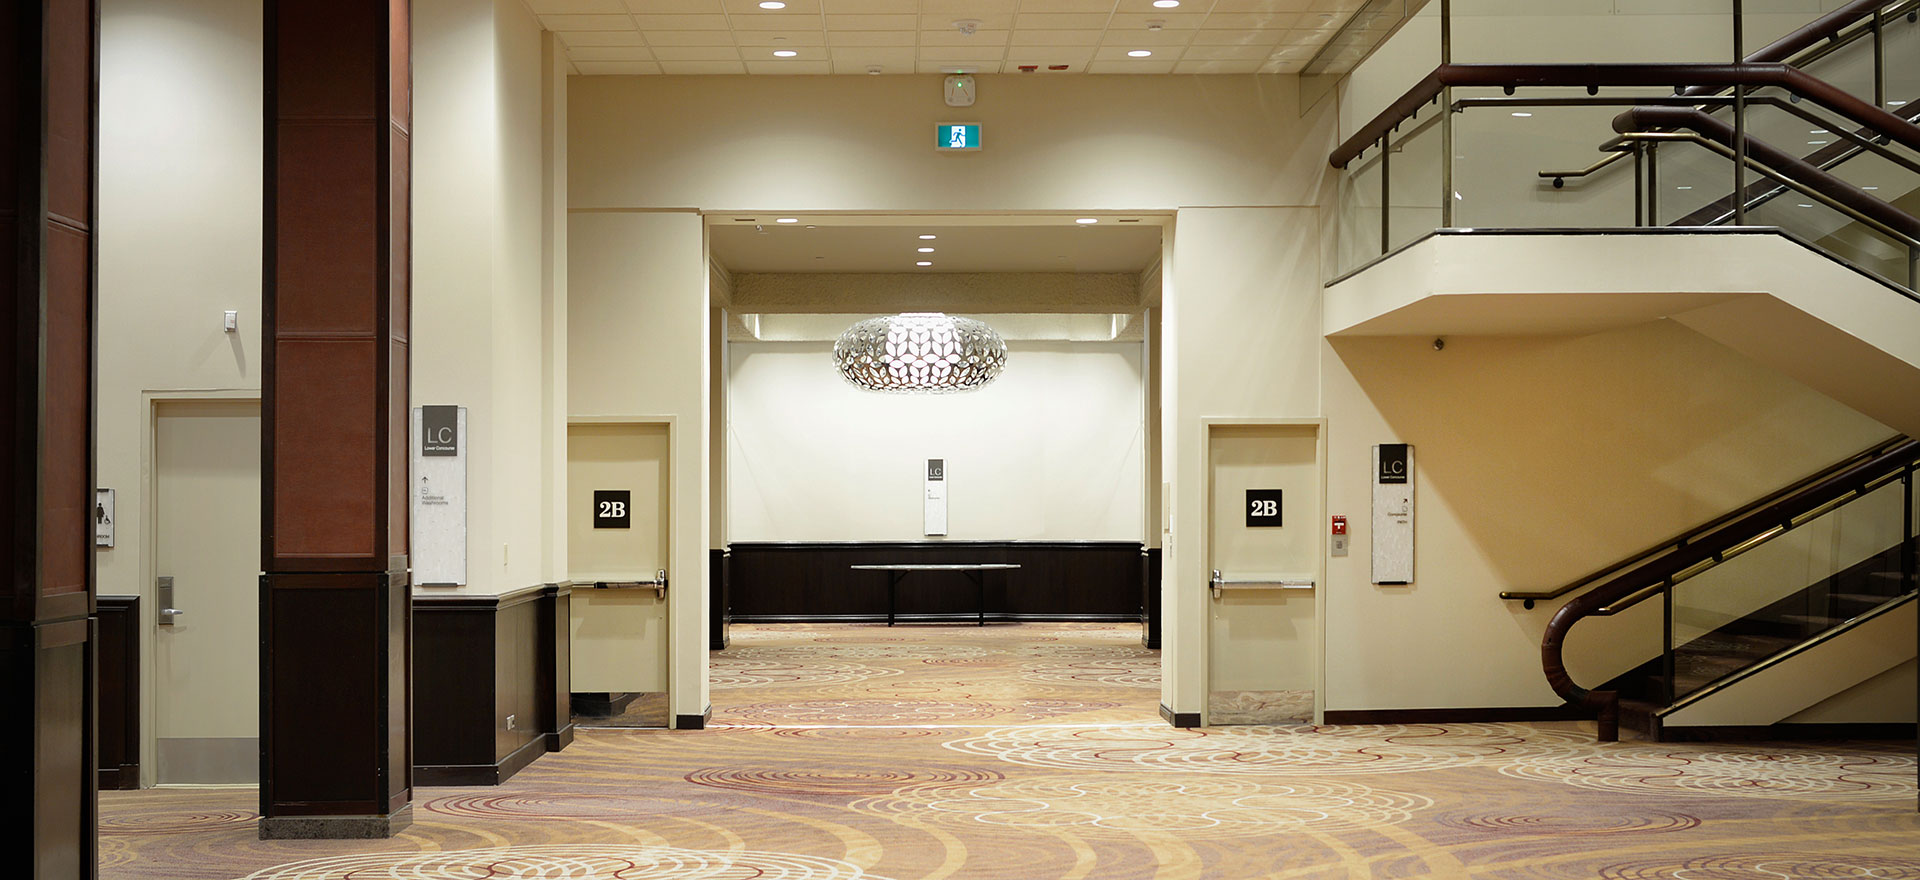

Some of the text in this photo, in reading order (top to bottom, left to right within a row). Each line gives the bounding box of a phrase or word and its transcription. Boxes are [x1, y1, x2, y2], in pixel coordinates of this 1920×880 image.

[427, 427, 452, 443] LC
[1383, 460, 1403, 474] LC
[599, 501, 625, 518] 2B
[1251, 500, 1277, 517] 2B
